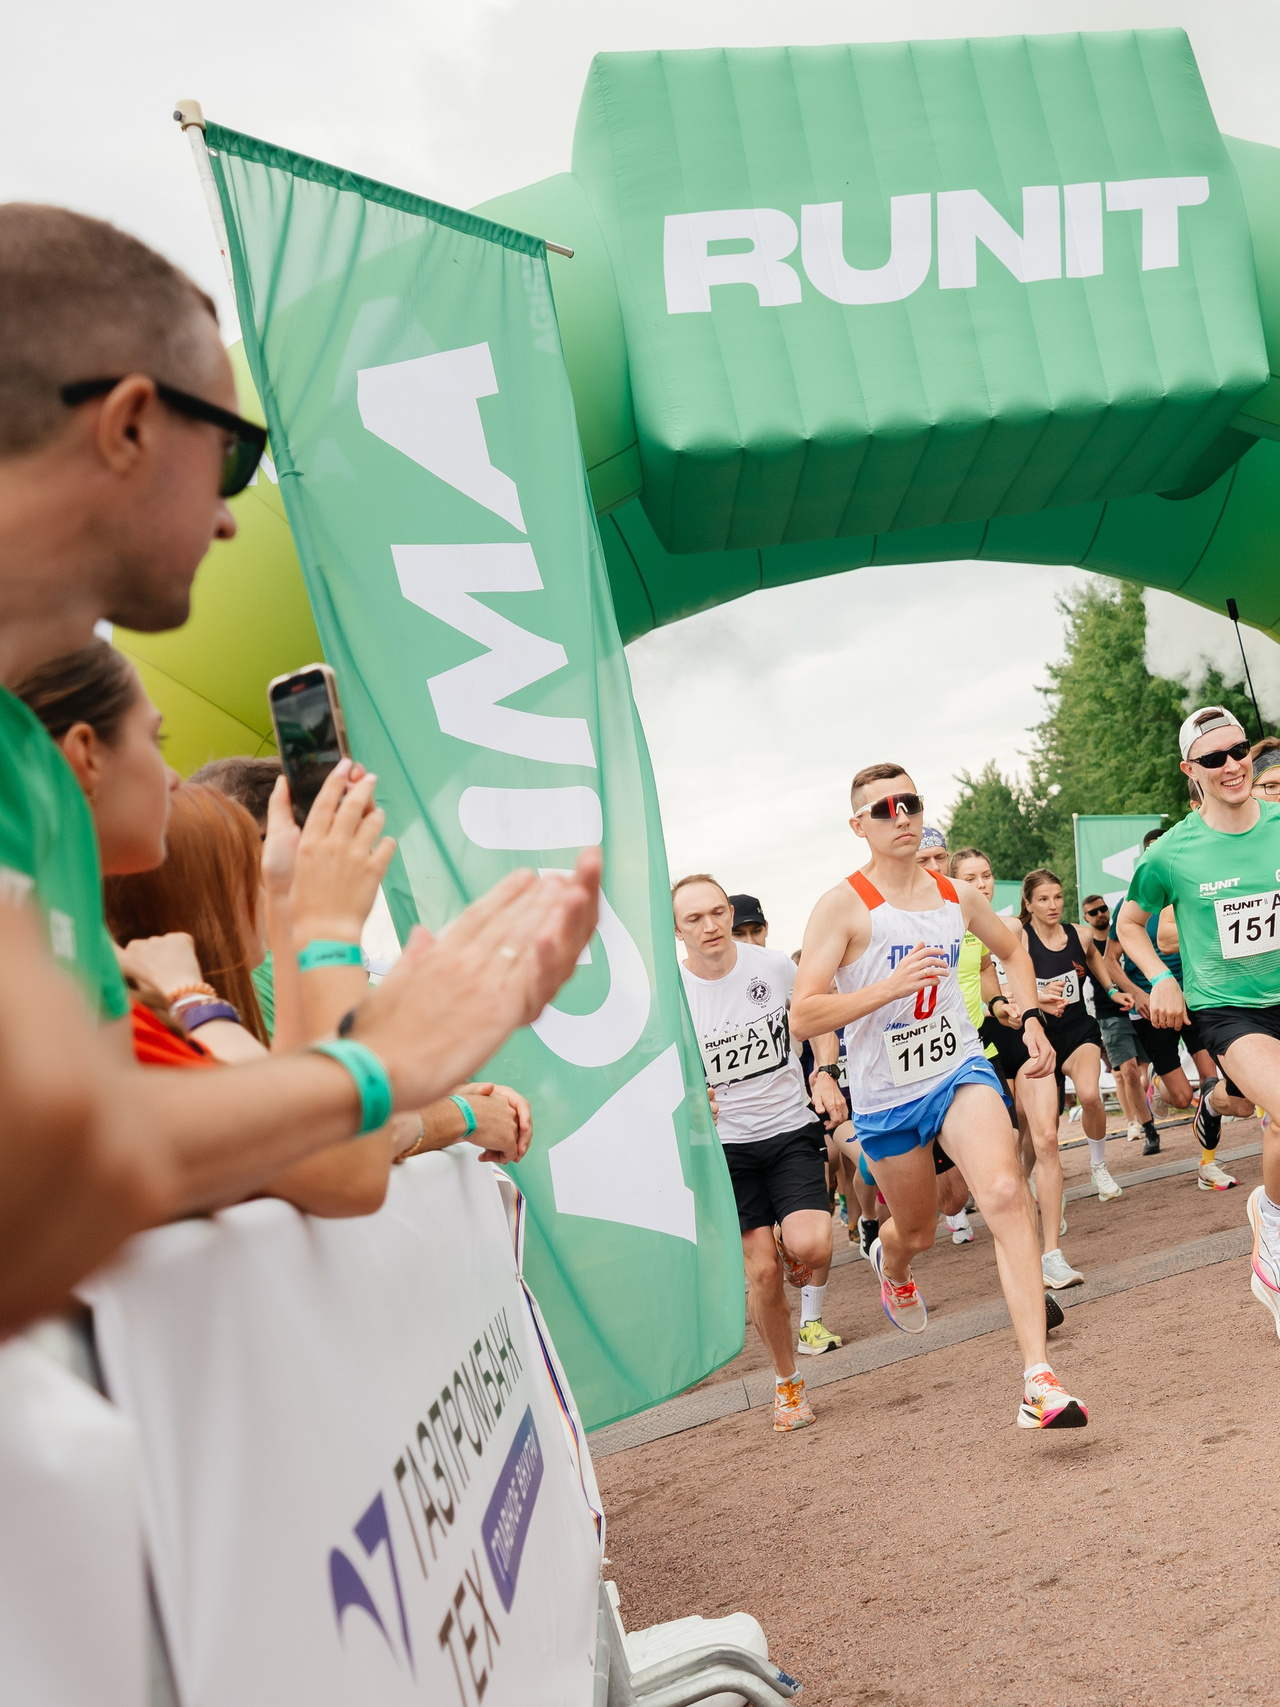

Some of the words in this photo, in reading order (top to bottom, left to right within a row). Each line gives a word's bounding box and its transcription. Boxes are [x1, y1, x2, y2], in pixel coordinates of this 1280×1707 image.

[663, 176, 1210, 314] RUNIT
[1199, 877, 1240, 892] RUNIT
[1223, 899, 1263, 912] RUNIT
[705, 1034, 739, 1049] RUNIT
[747, 1028, 759, 1042] A
[891, 1024, 928, 1043] RUNIT
[940, 1015, 952, 1033] A
[710, 1039, 769, 1073] 1272
[898, 1032, 957, 1072] 1159
[393, 1306, 523, 1581] ГАЗПРОМБАНК
[438, 1549, 501, 1707] ТЕХ
